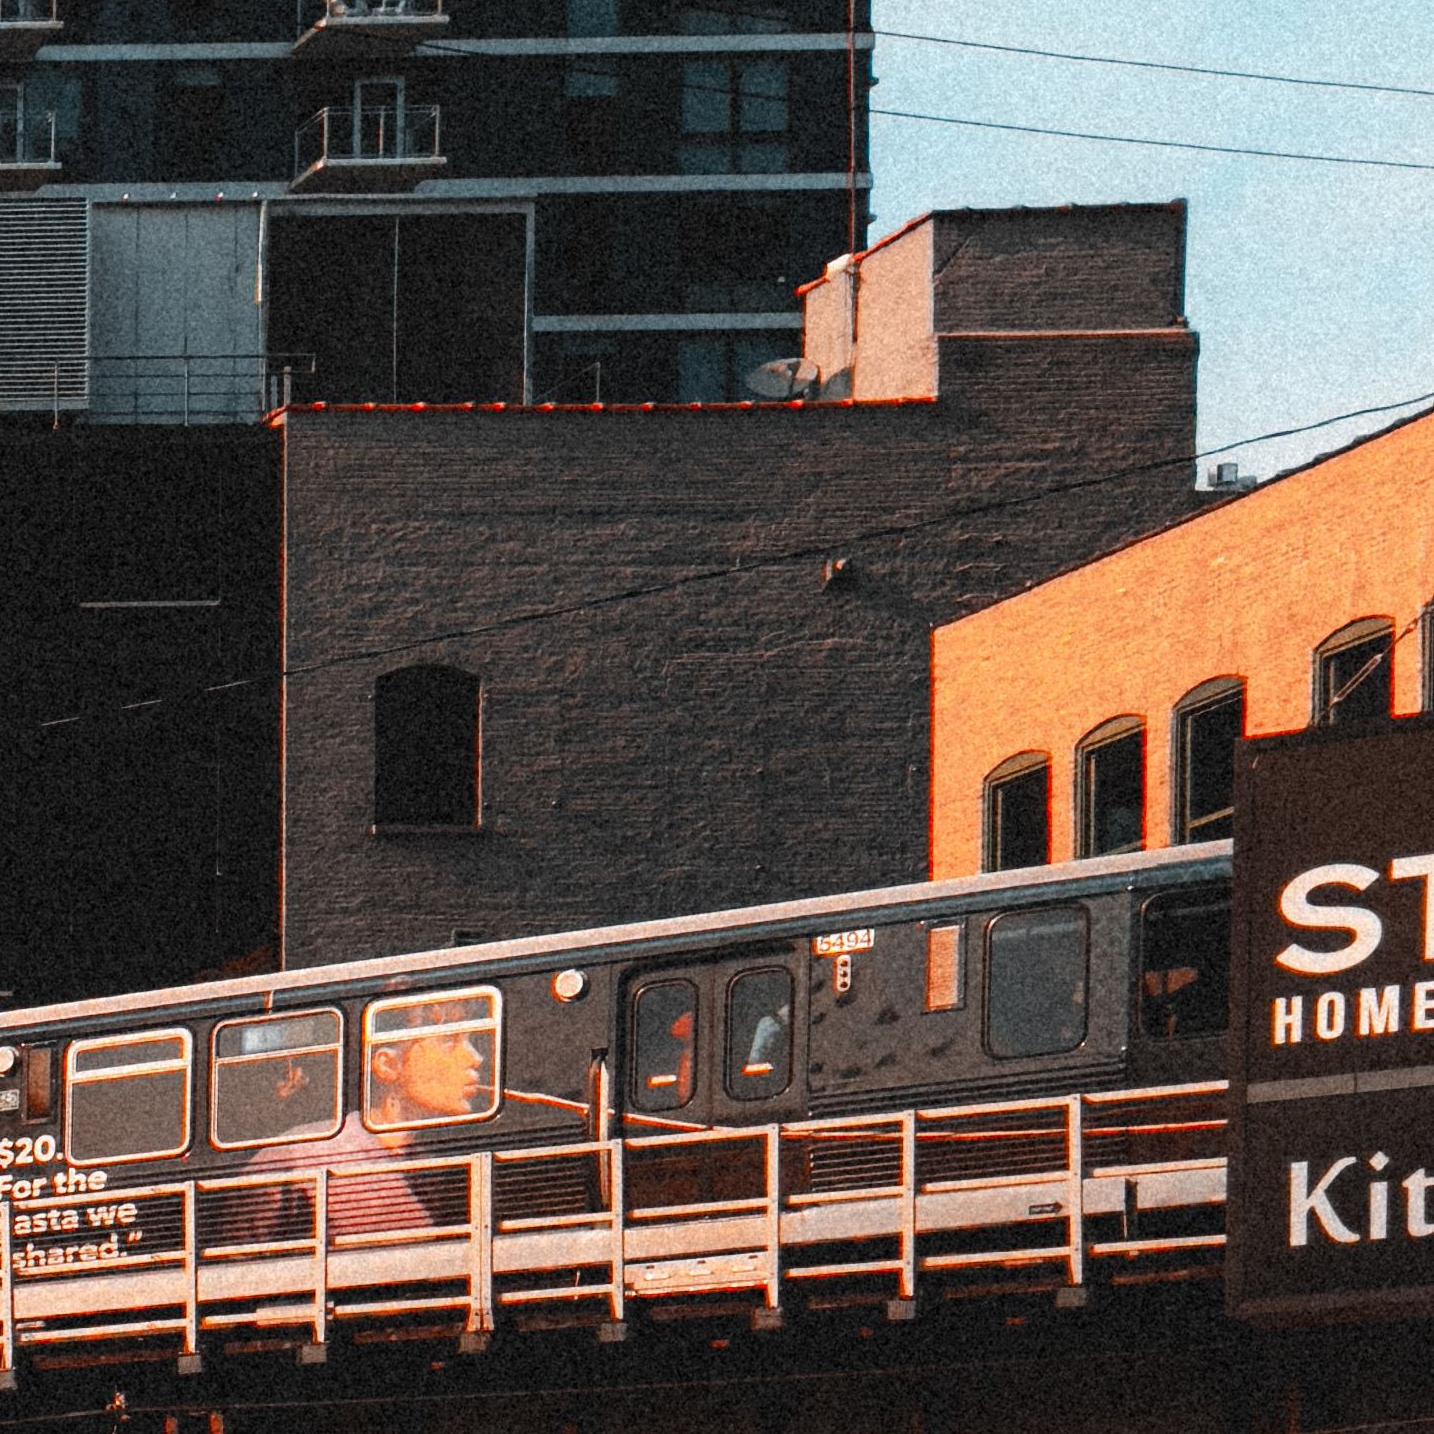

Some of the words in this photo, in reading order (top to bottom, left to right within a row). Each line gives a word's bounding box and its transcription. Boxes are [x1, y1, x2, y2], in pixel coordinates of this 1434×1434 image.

[819, 930, 872, 952] 5494
[52, 1167, 108, 1194] the
[86, 1201, 138, 1226] we
